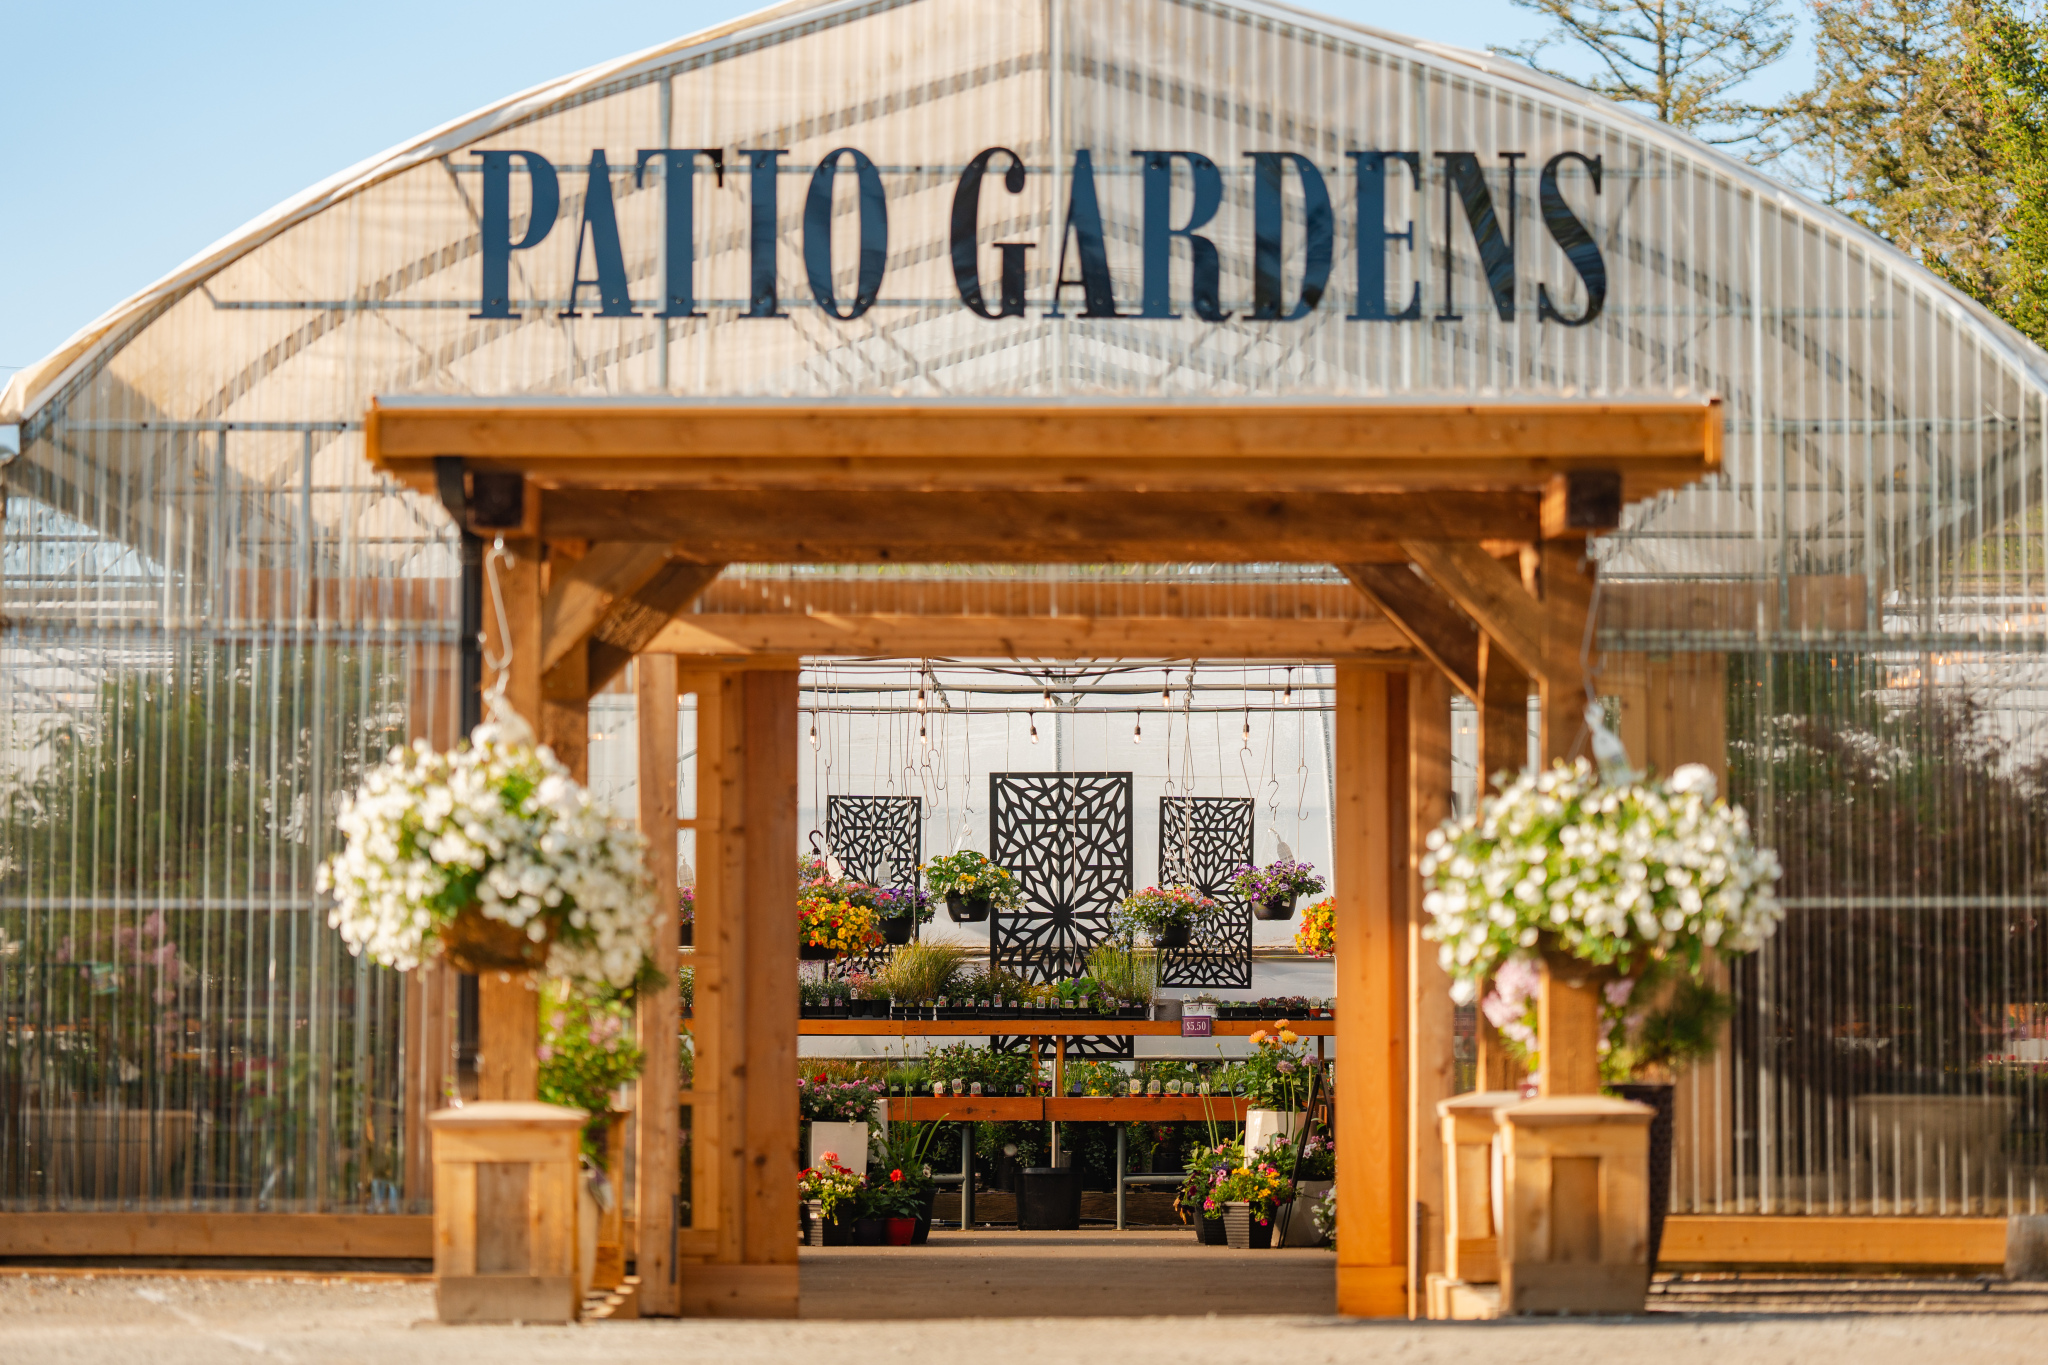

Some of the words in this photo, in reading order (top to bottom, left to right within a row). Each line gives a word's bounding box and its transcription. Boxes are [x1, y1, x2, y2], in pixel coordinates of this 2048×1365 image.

[470, 148, 888, 320] PATIO
[951, 147, 1607, 327] GARDENS
[1186, 1021, 1207, 1031] $5.50
